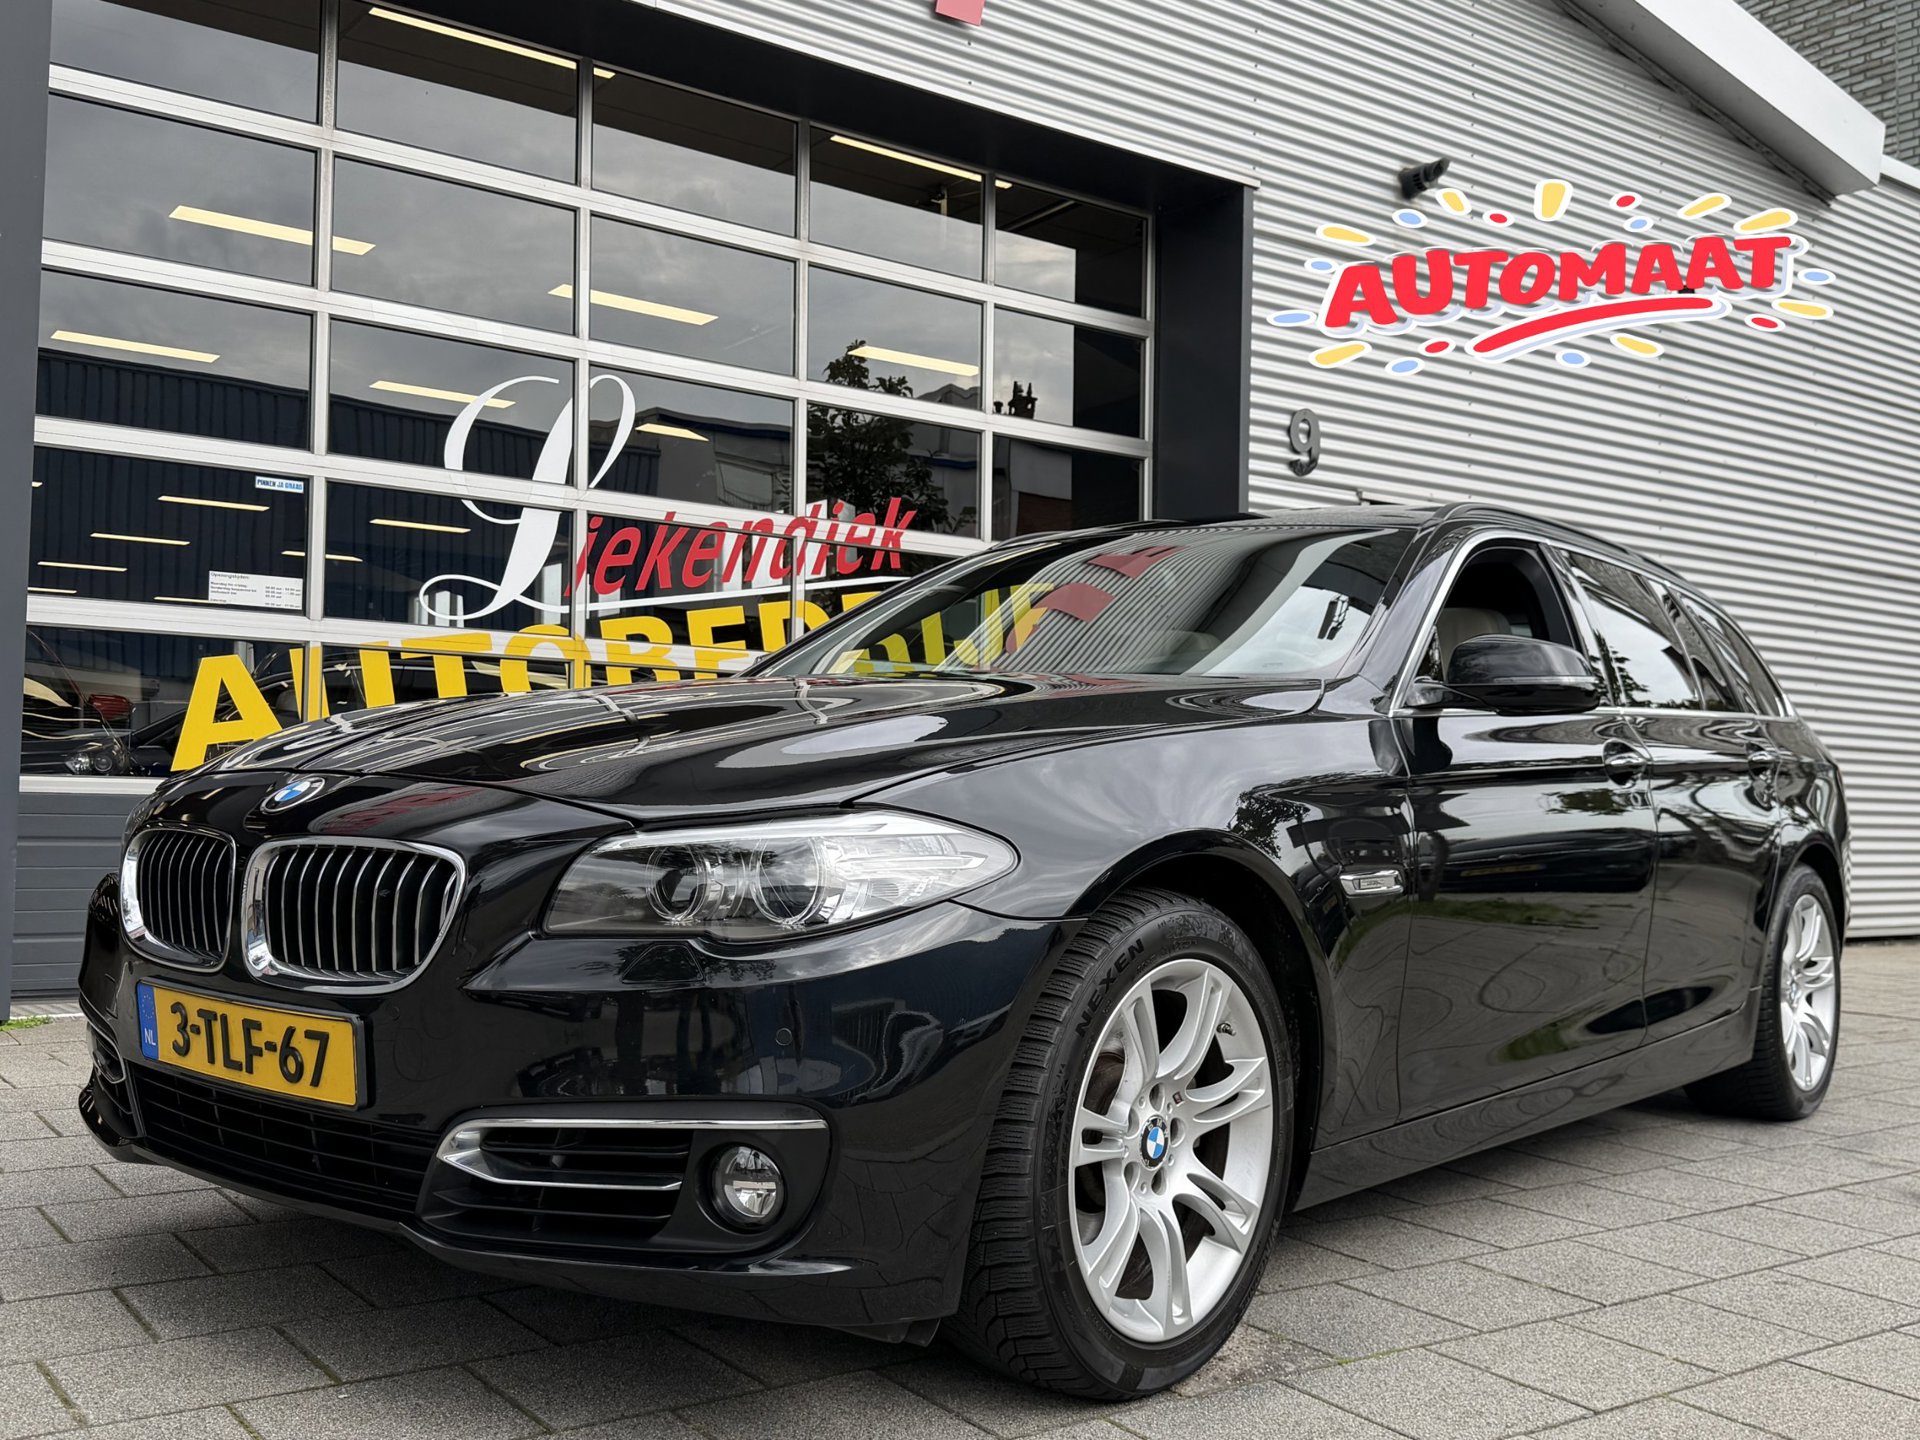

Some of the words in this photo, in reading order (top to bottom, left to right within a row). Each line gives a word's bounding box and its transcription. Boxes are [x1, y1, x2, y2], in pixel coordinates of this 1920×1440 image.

[1287, 408, 1321, 477] 9
[420, 375, 917, 620] Liekendiek
[1075, 938, 1145, 1038] NEXEN
[144, 1027, 157, 1046] NL
[170, 1001, 330, 1088] 3-TLF-67
